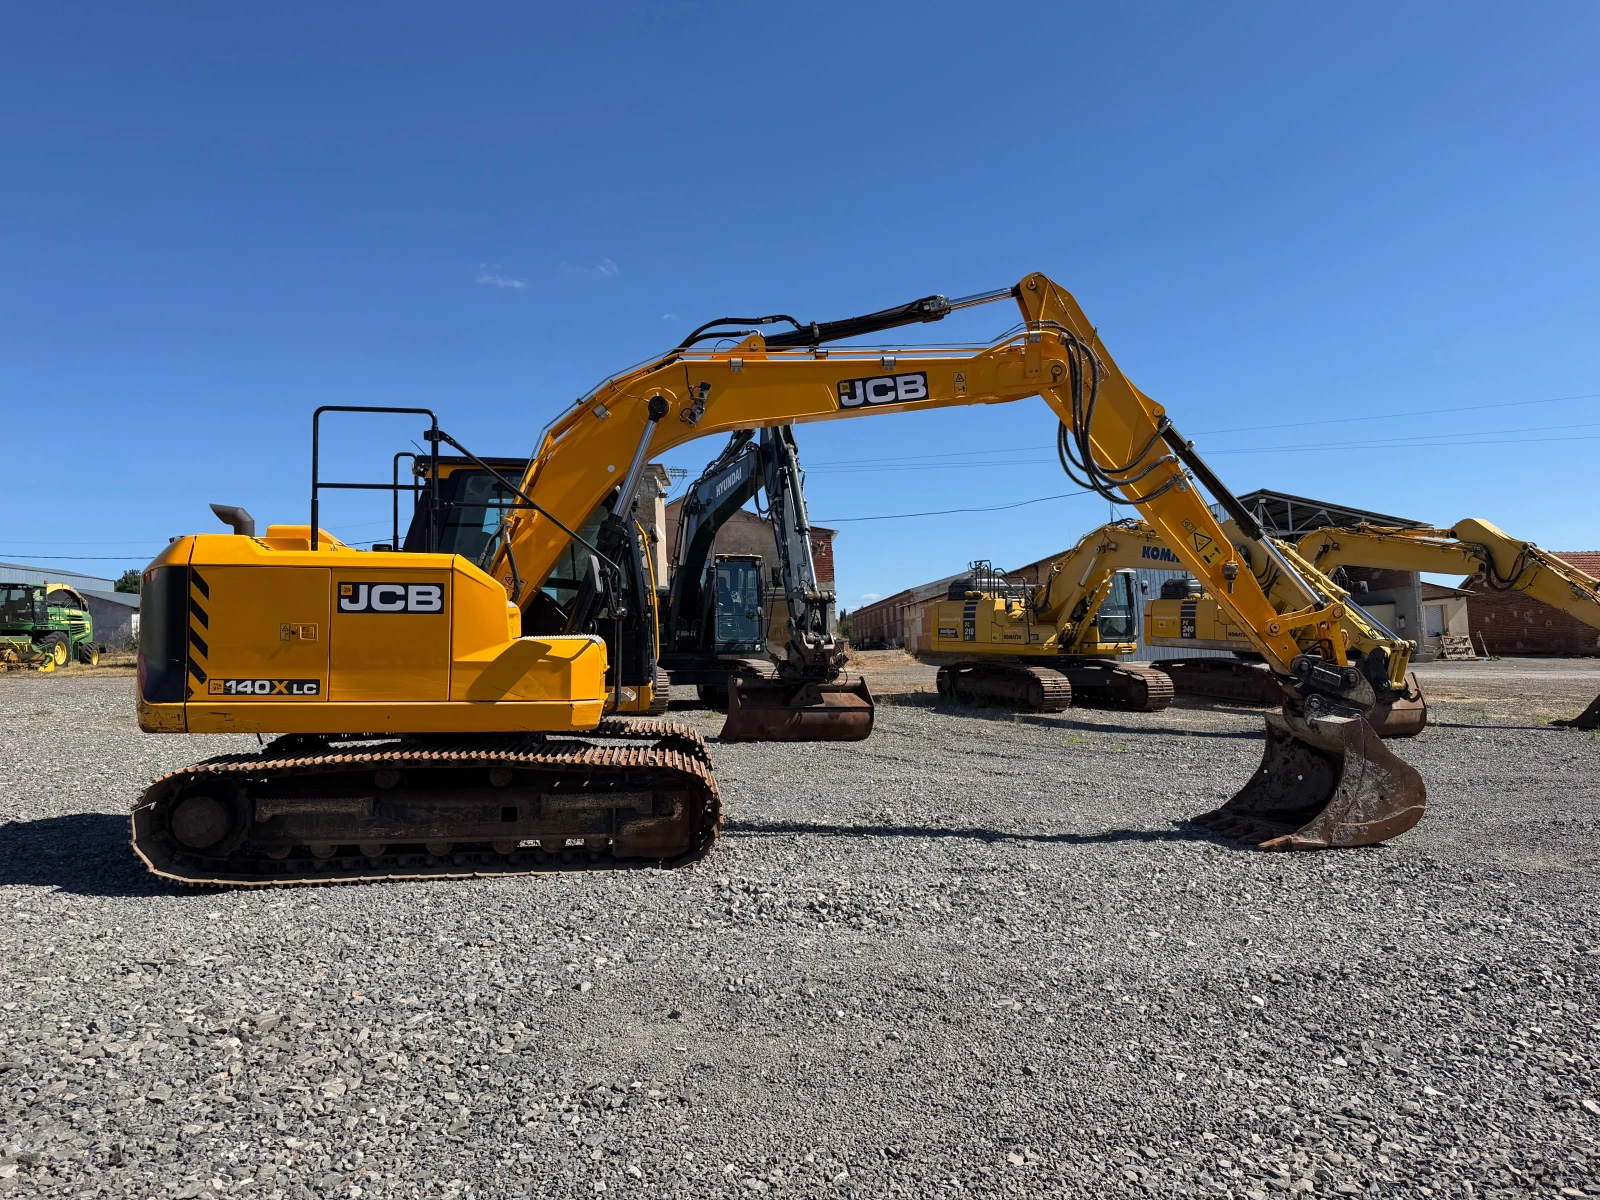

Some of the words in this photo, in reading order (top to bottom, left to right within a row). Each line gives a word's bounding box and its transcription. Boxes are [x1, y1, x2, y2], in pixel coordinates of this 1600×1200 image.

[840, 374, 927, 407] JCB
[715, 466, 742, 498] HYUNDAI
[340, 584, 442, 612] JCB
[225, 680, 289, 694] 140X
[292, 683, 317, 694] LC
